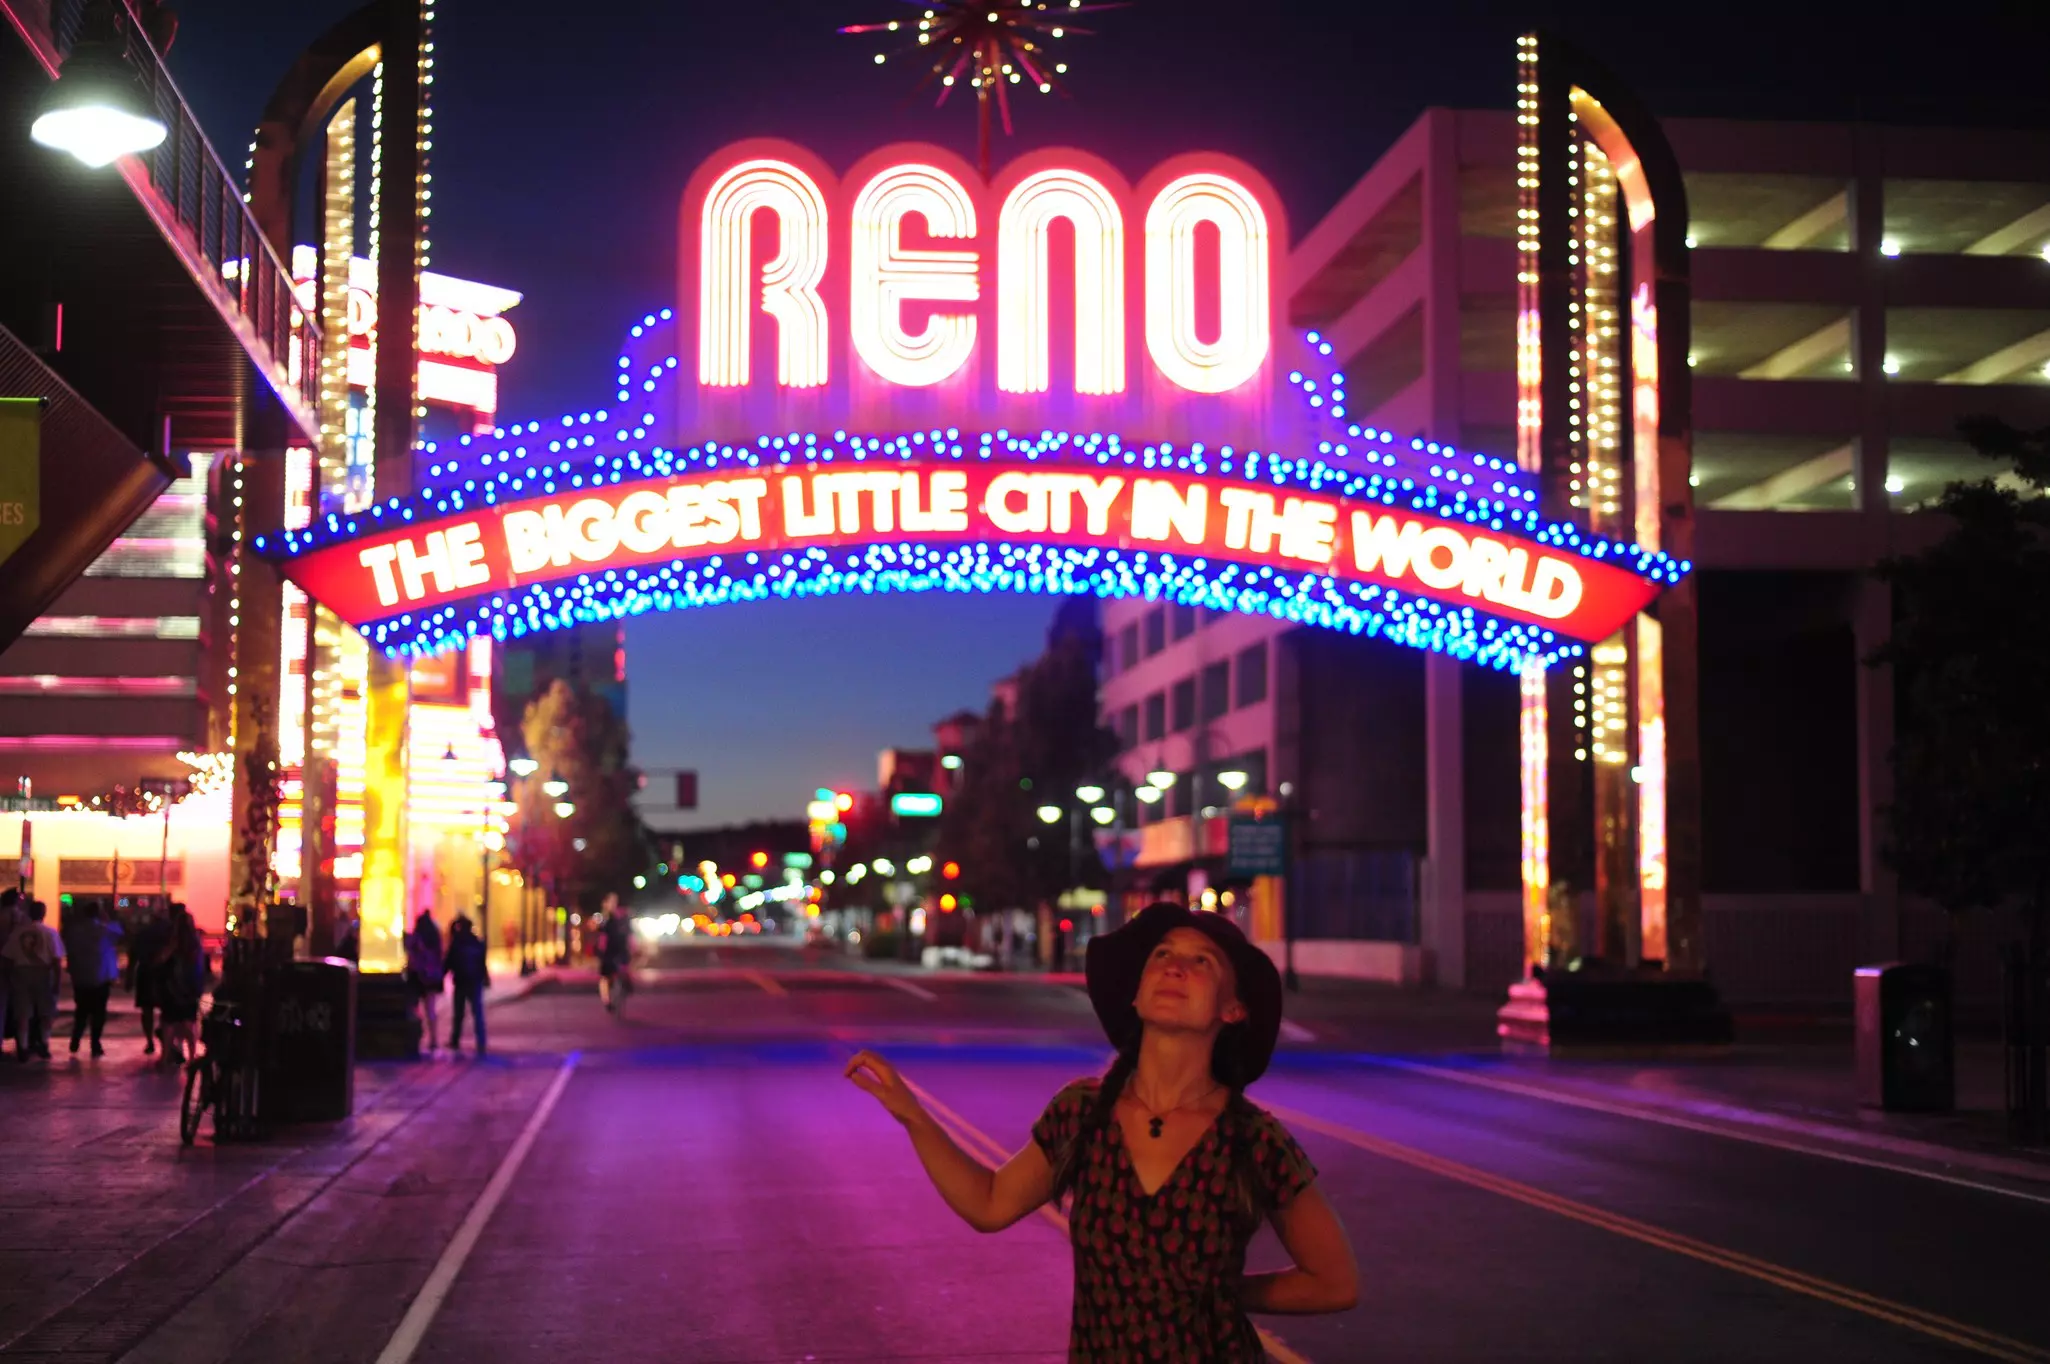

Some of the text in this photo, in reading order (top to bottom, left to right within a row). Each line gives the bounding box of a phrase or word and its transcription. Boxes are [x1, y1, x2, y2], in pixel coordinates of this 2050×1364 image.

[700, 159, 1269, 395] RENO
[359, 471, 1583, 619] THE BIGGEST LITTLE CITY IN THE WORLD
